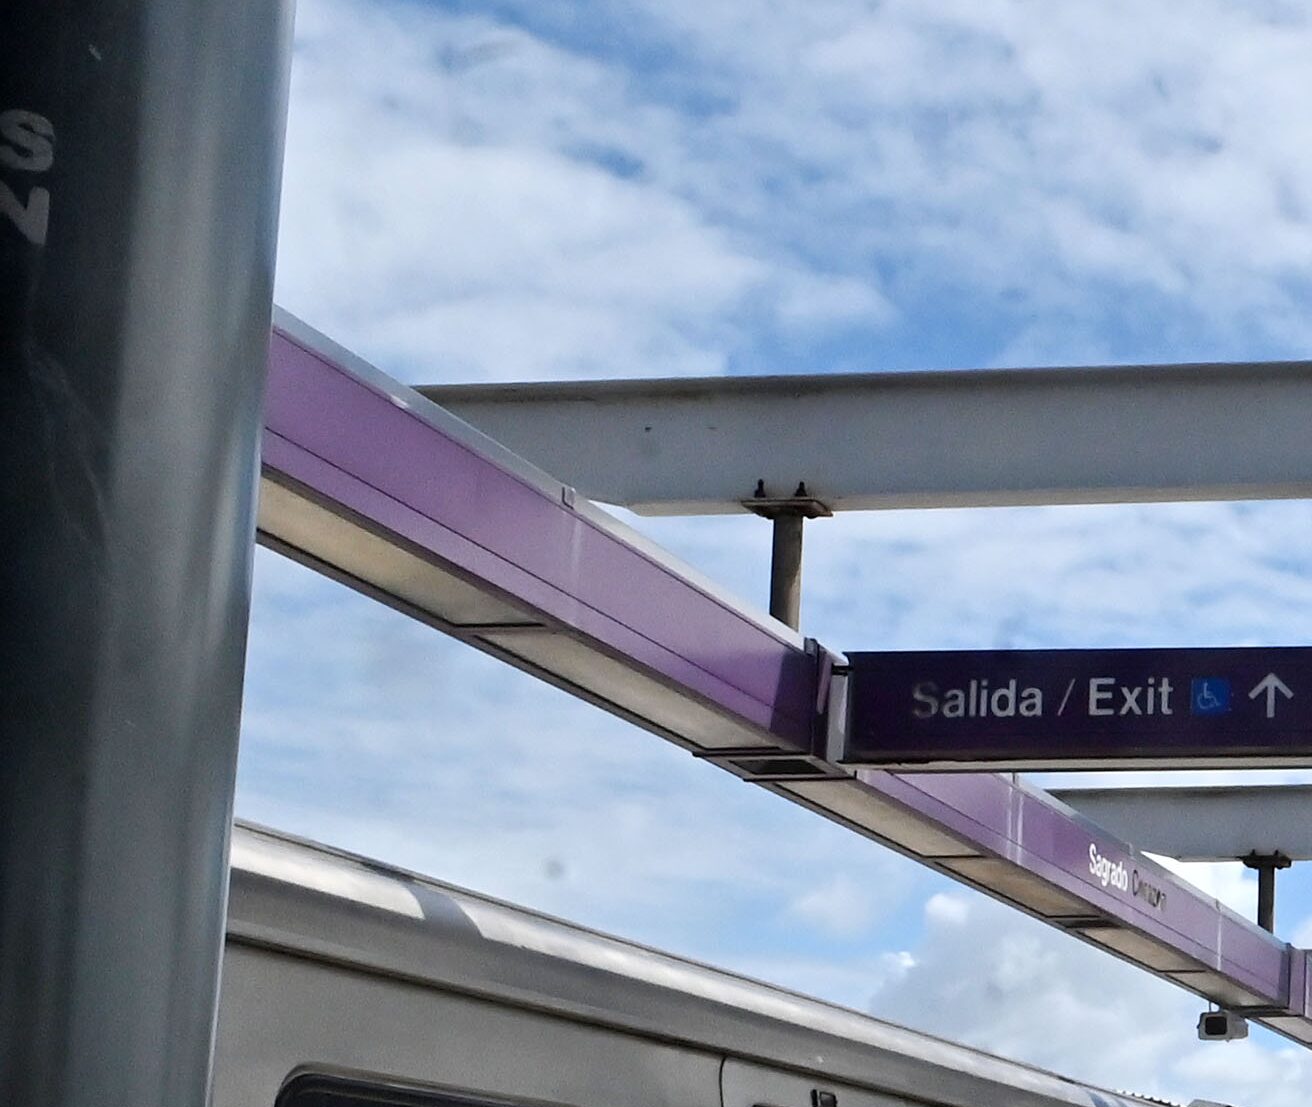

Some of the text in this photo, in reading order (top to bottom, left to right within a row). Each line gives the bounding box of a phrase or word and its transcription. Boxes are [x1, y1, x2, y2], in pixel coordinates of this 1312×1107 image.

[912, 679, 1043, 719] Salida
[1088, 677, 1174, 716] Exit
[1089, 843, 1128, 892] Sagrado
